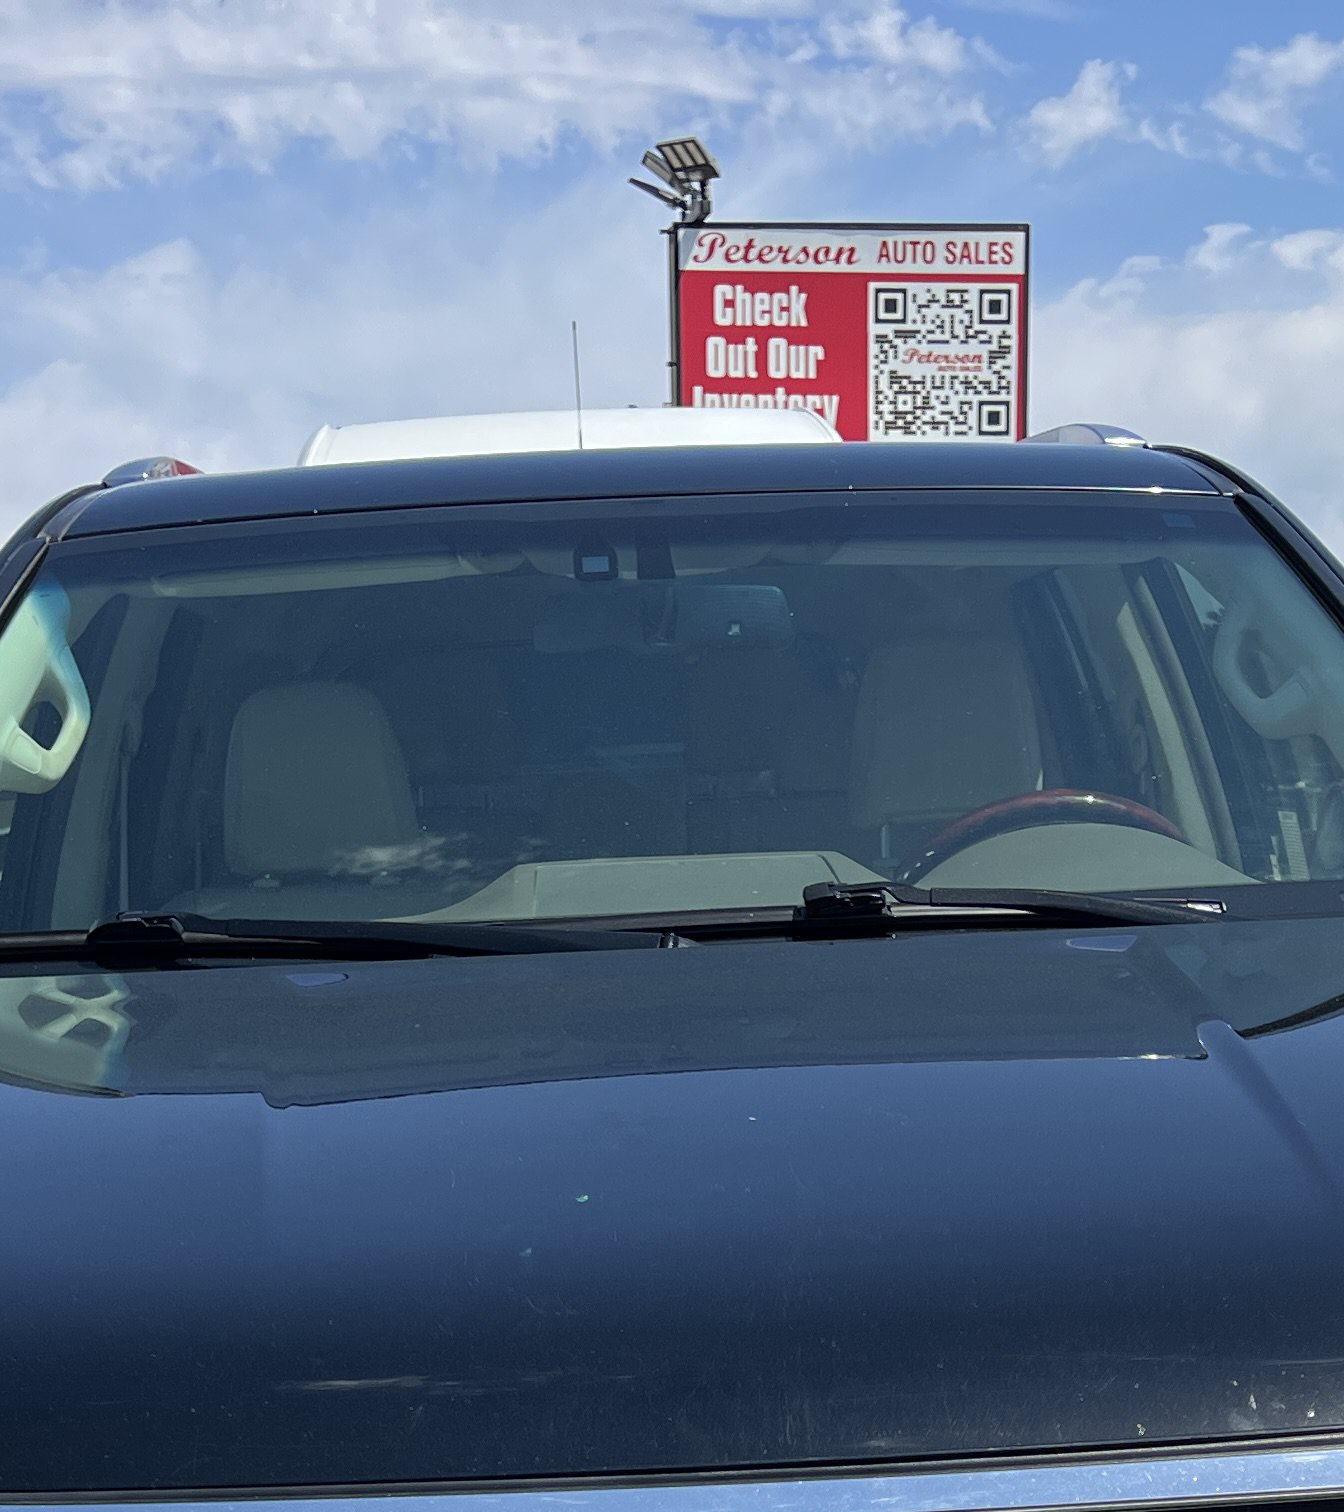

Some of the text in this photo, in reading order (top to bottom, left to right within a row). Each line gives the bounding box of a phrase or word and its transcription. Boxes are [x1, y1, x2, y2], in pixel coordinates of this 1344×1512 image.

[693, 232, 861, 265] Peterson
[877, 240, 1014, 265] AUTO SALES
[713, 284, 808, 327] Check
[706, 336, 825, 379] Out Our
